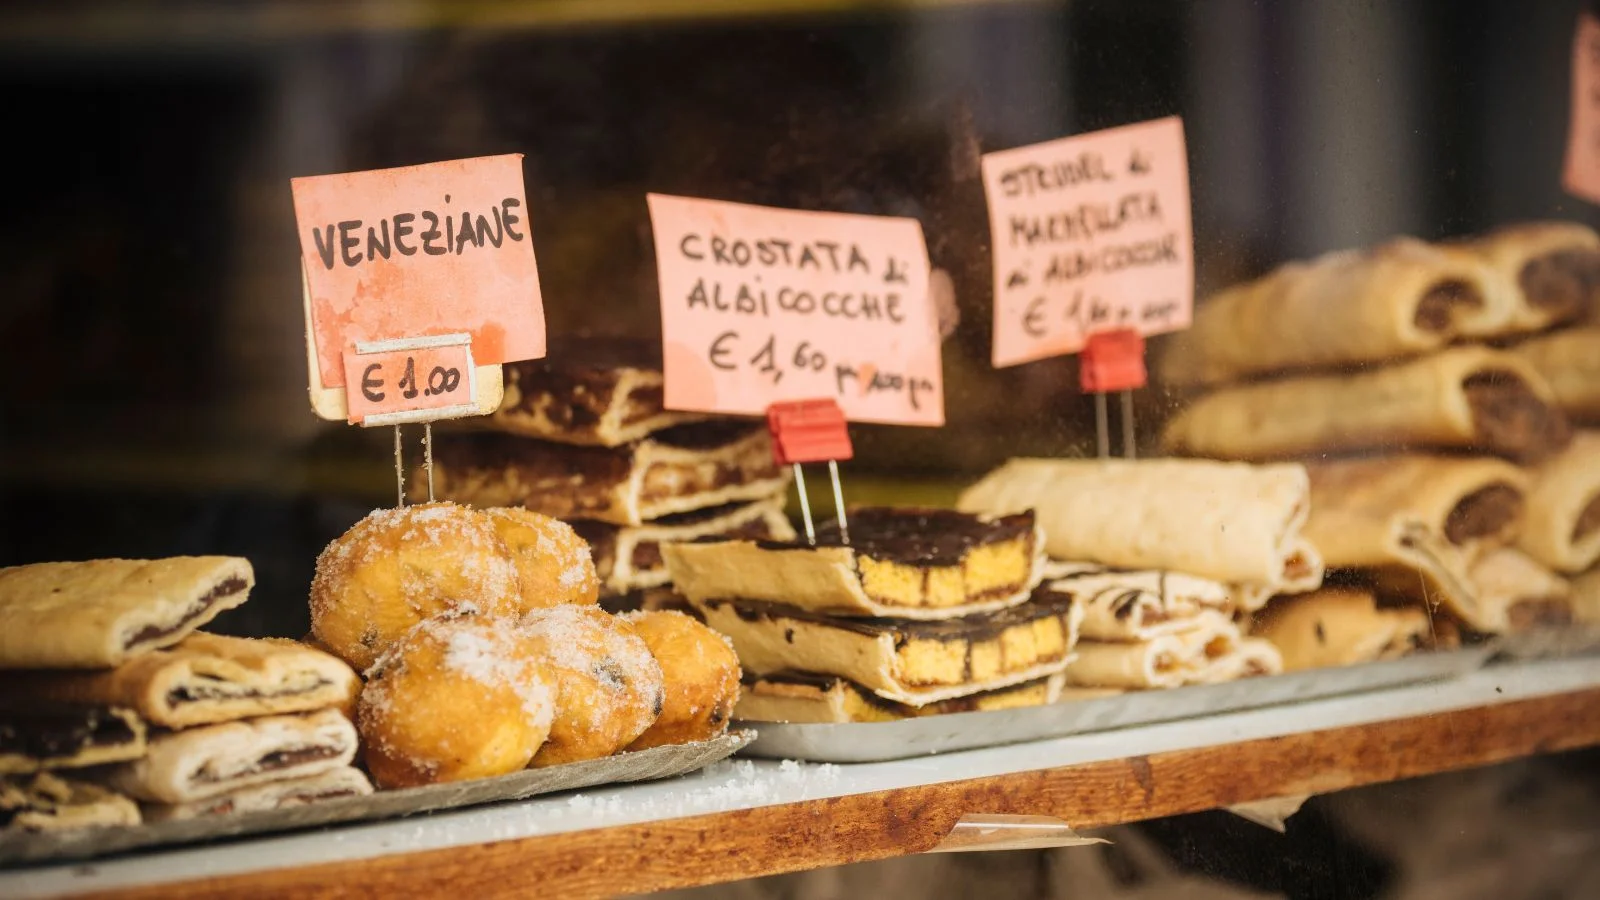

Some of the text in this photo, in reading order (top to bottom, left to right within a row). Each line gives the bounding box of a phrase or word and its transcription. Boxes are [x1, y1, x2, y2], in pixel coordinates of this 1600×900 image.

[312, 193, 524, 271] VENEZIANE
[679, 233, 870, 275] CROSTATA
[686, 274, 905, 325] ALBICOCCHE
[360, 356, 461, 402] € 1.00
[709, 331, 740, 370] €
[750, 334, 827, 387] 1,60
